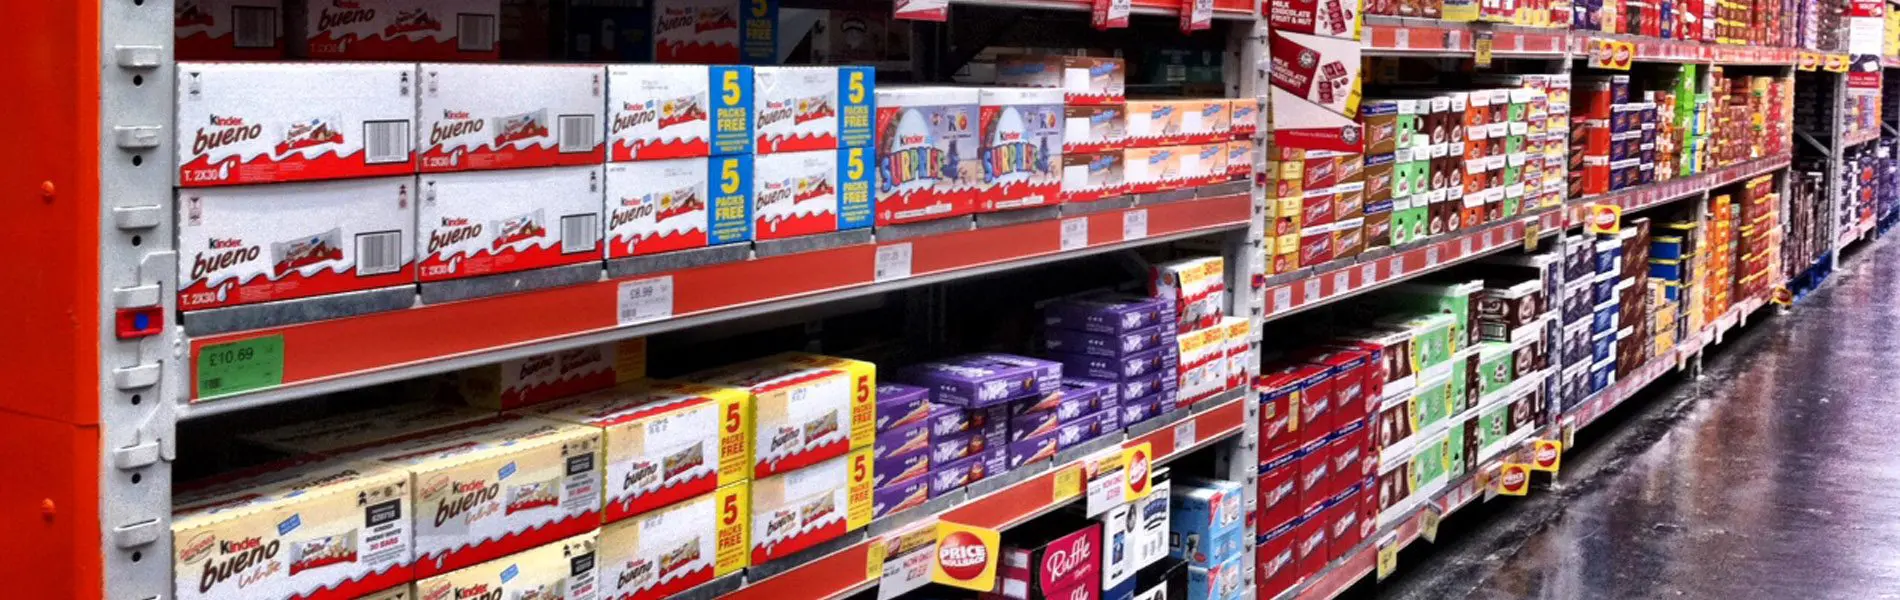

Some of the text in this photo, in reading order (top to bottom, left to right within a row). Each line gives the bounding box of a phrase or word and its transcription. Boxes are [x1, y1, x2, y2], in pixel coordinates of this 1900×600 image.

[317, 7, 376, 31] bueno
[722, 70, 741, 105] 5
[849, 71, 865, 104] 5
[210, 114, 243, 126] Kinder
[444, 109, 469, 119] Kinder
[612, 109, 655, 134] bueno
[192, 122, 262, 155] bueno
[430, 118, 484, 145] bueno
[900, 133, 924, 145] Kinder
[1000, 131, 1022, 142] Kinder
[721, 159, 740, 194] 5
[847, 148, 864, 180] 5
[880, 146, 944, 193] SURPRISE
[983, 141, 1038, 184] SURPRISE
[441, 216, 468, 227] Kinder
[609, 203, 653, 231] bueno
[208, 238, 242, 249] Kinder
[428, 223, 482, 254] bueno
[190, 245, 260, 280] bueno
[209, 347, 254, 367] £10.69
[857, 375, 870, 403] 5
[726, 401, 741, 433] 5
[854, 455, 867, 482] 5
[453, 479, 485, 495] Kinder
[434, 482, 500, 528] bueno
[723, 494, 738, 525] 5
[219, 536, 262, 556] Kinder
[941, 545, 986, 560] PRICE
[1046, 533, 1091, 583] Ruffle
[199, 539, 281, 594] bueno
[454, 582, 488, 600] Kinder
